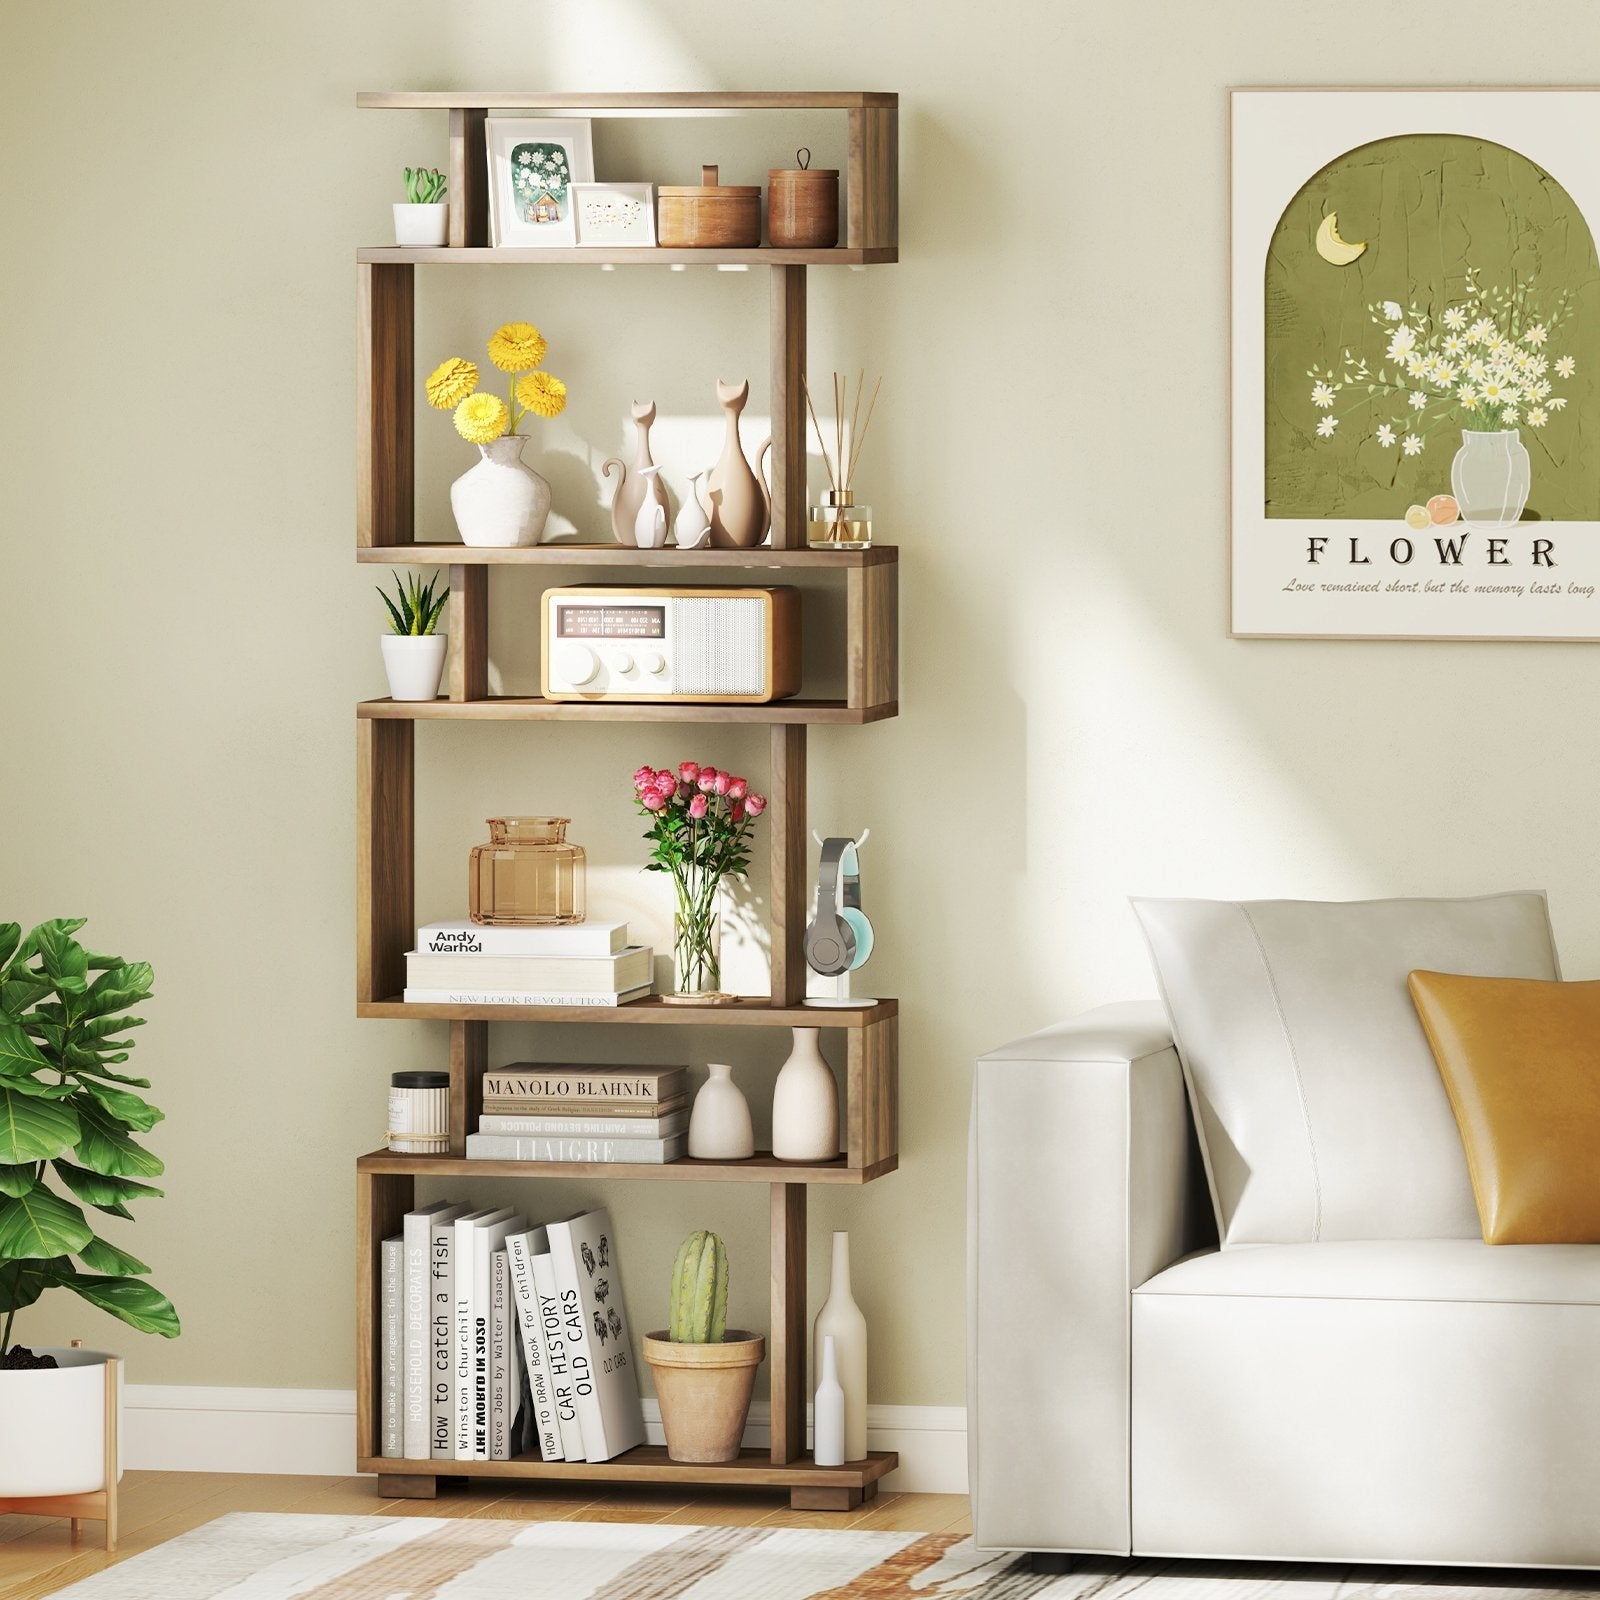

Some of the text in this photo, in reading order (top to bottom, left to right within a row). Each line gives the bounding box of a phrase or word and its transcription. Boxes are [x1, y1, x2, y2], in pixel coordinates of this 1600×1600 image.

[1307, 532, 1559, 568] FLOWER
[1282, 577, 1315, 592] Love
[1320, 580, 1381, 592] remained
[1450, 579, 1469, 593] the
[1473, 583, 1526, 597] memory
[1530, 581, 1561, 594] lasts
[1567, 582, 1595, 598] long
[429, 942, 482, 952] Warhol
[436, 931, 476, 944] Andy
[449, 995, 611, 1006] NEW LOOK REVOLUTION
[488, 1079, 652, 1096] MANOLO BLAHNÍK
[500, 1122, 541, 1132] POLLOCK
[544, 1122, 581, 1132] BEYOND
[584, 1123, 626, 1134] PAINTING
[388, 1246, 398, 1450] How to make an arrangement in the house
[410, 1248, 423, 1422] HOUSEHOLD DECORATES
[433, 1237, 448, 1450] How to catch a fish
[512, 1240, 555, 1456] HOW TO DRAW Book for children
[560, 1289, 592, 1396] OLD CARS
[494, 1255, 505, 1456] Steve Jobs by Walter Isaacson
[539, 1294, 575, 1421] CAR HISTORY
[458, 1299, 468, 1450] Winston Churchill
